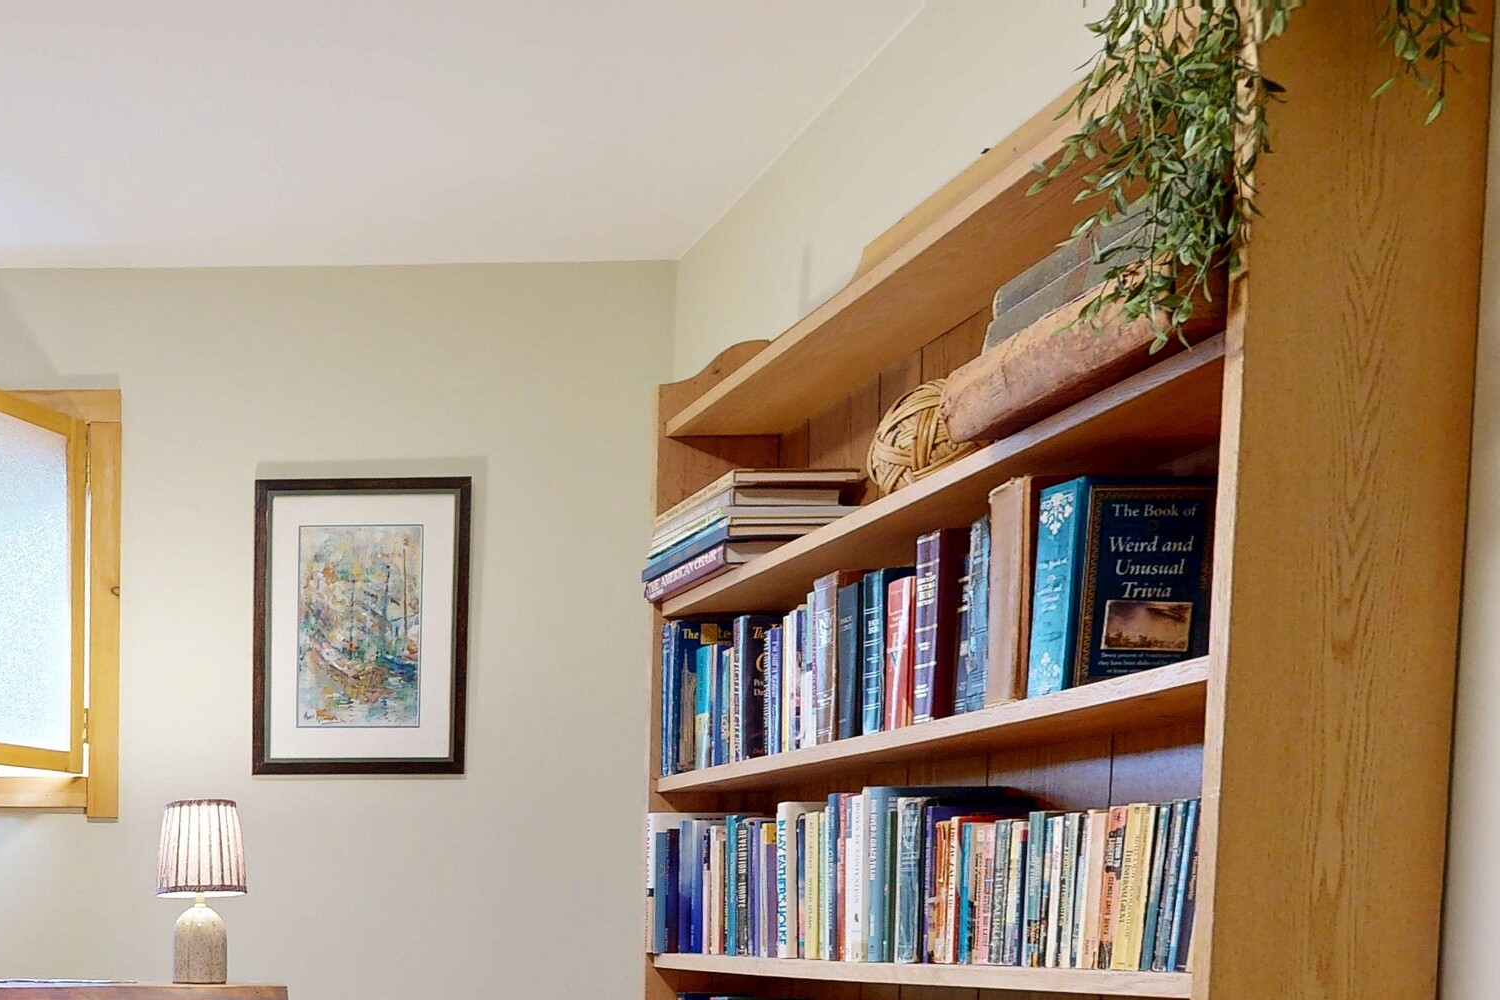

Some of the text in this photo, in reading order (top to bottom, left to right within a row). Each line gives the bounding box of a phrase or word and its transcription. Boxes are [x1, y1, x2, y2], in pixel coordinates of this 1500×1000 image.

[1112, 503, 1197, 517] The Book of
[1108, 535, 1195, 553] Weird and
[1114, 559, 1185, 576] Unusual
[1120, 581, 1172, 599] Trivia
[738, 830, 747, 874] REVELATION
[778, 820, 787, 946] IN MY FATHER'S HOUSE
[990, 871, 1004, 948] THESAURUS
